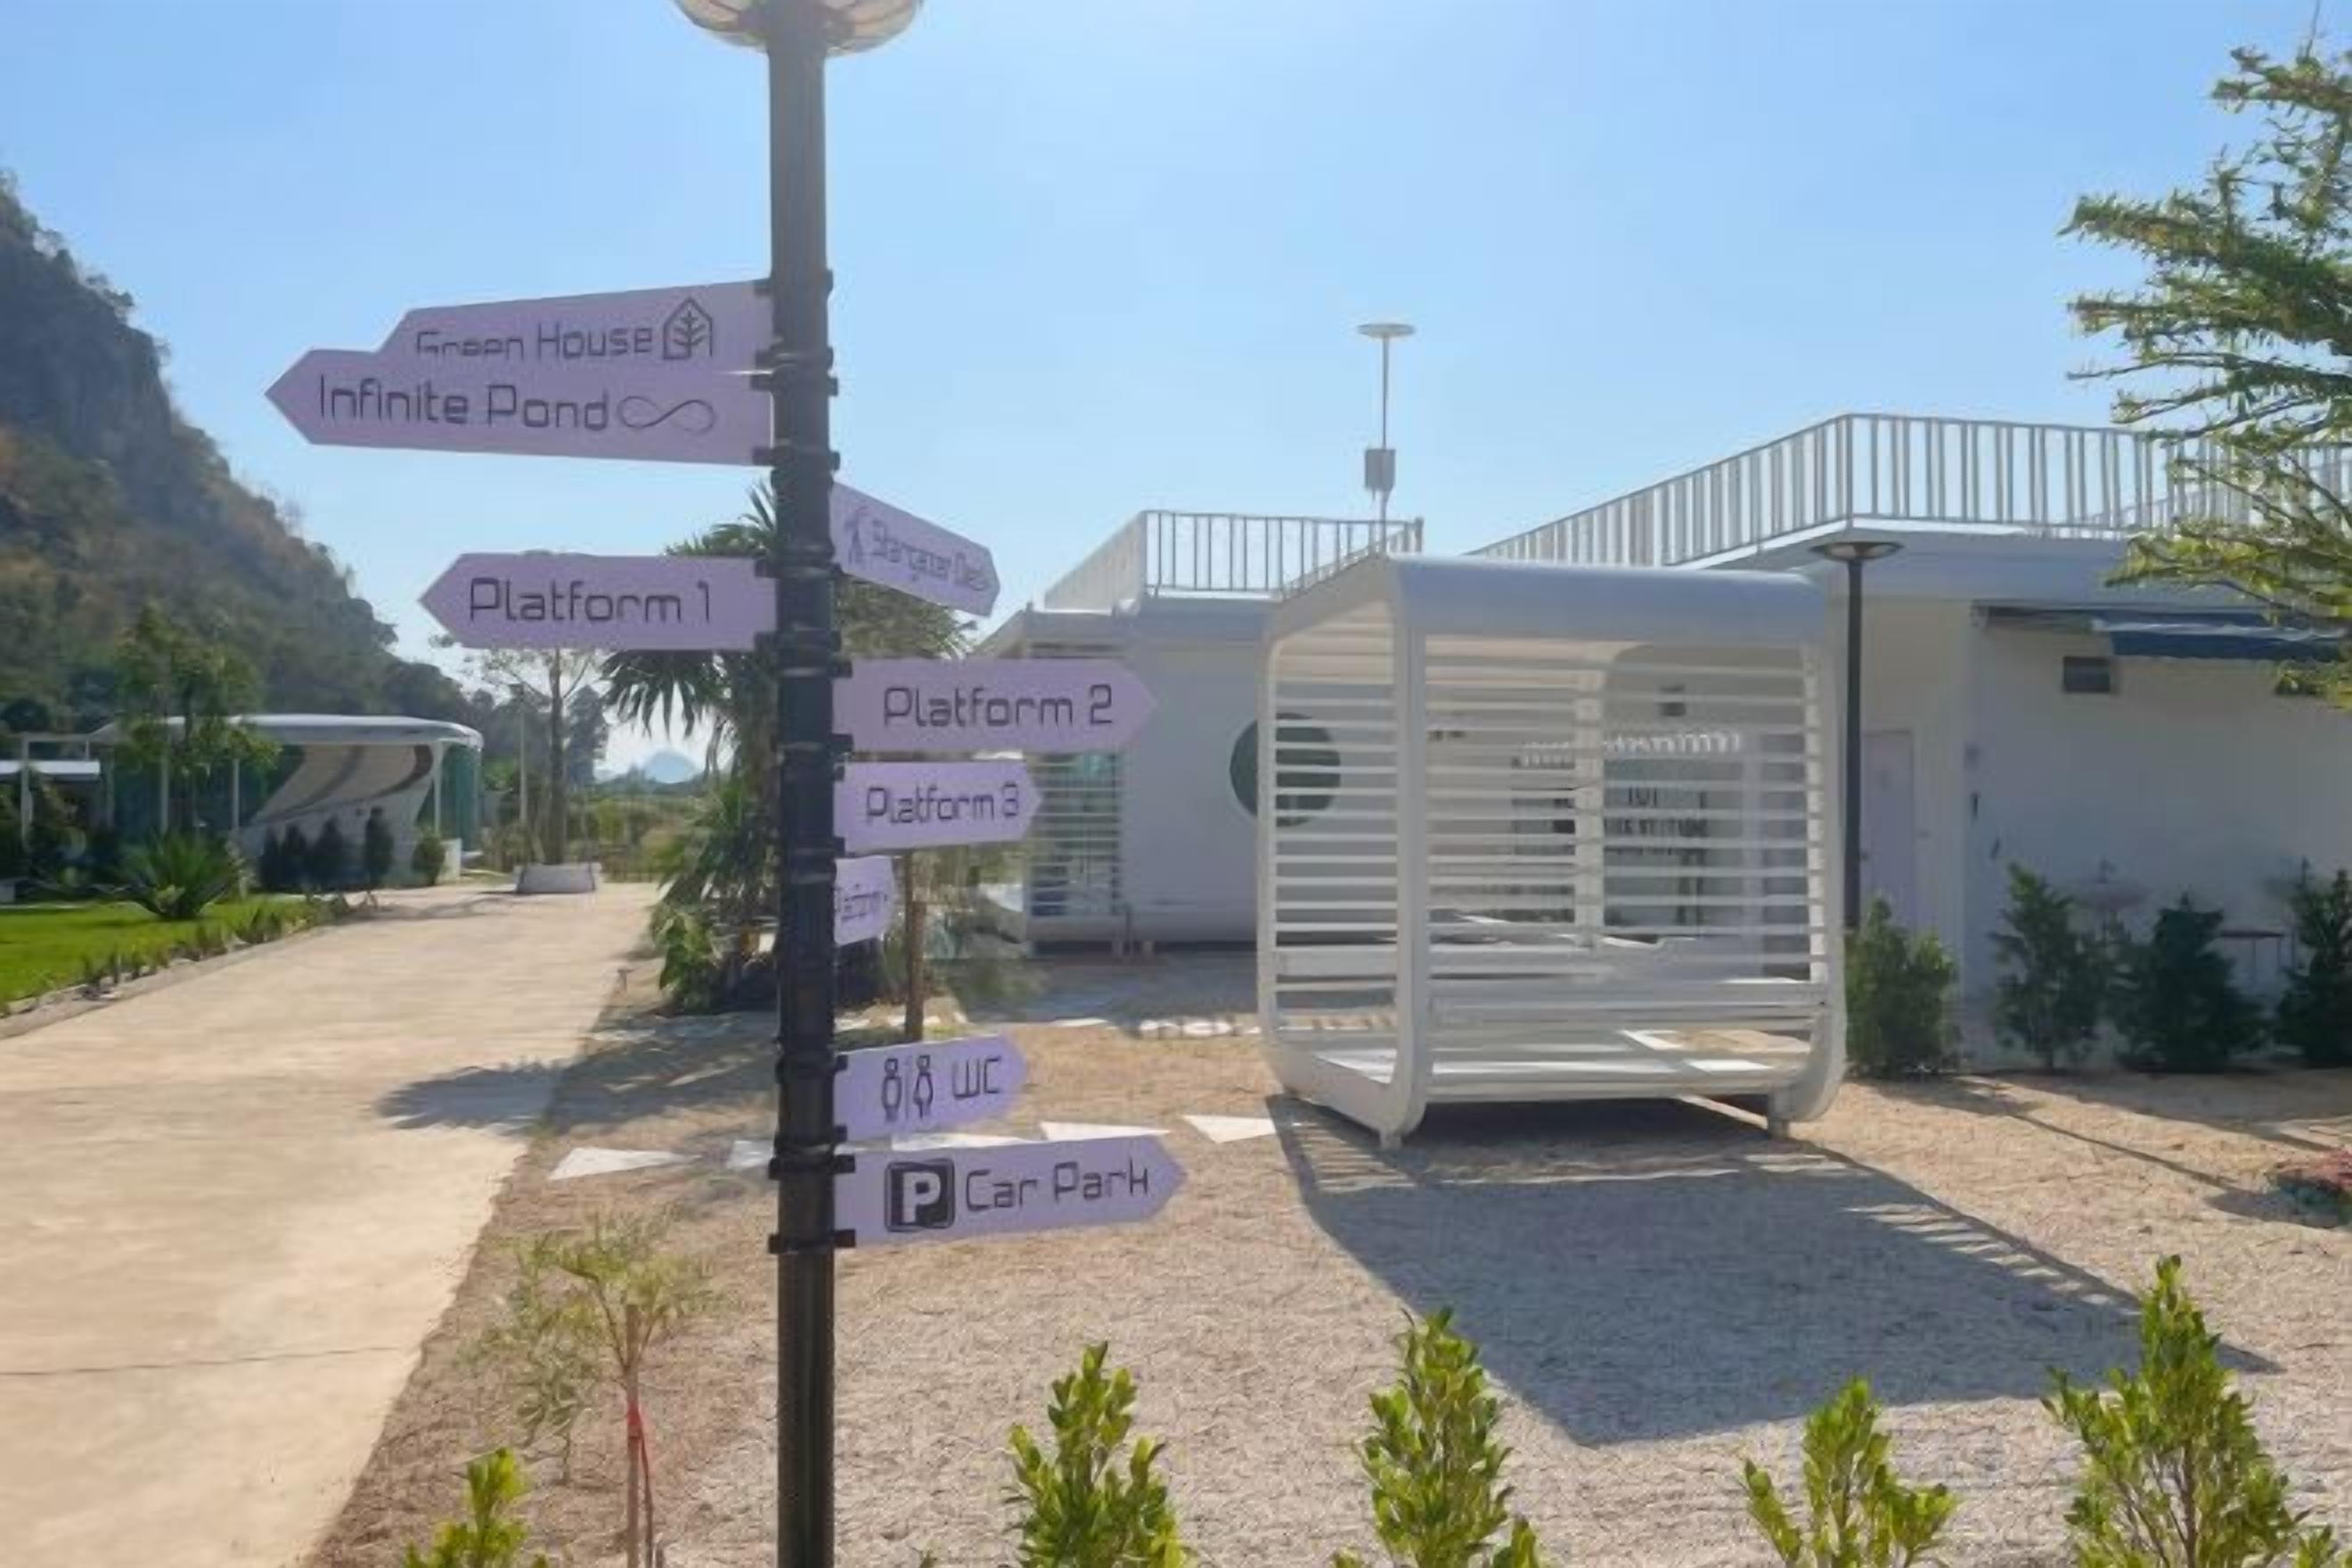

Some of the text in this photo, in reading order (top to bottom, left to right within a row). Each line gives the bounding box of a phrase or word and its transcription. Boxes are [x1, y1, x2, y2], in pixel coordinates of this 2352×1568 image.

[537, 322, 653, 359] House
[319, 375, 609, 431] Infinite Pond
[470, 577, 709, 623] Platform 1
[883, 683, 1113, 728] Platform 2
[865, 782, 1019, 825] Platform 3
[951, 1055, 1002, 1098] WC
[966, 1169, 1039, 1212] Car
[1052, 1157, 1150, 1202] Park
